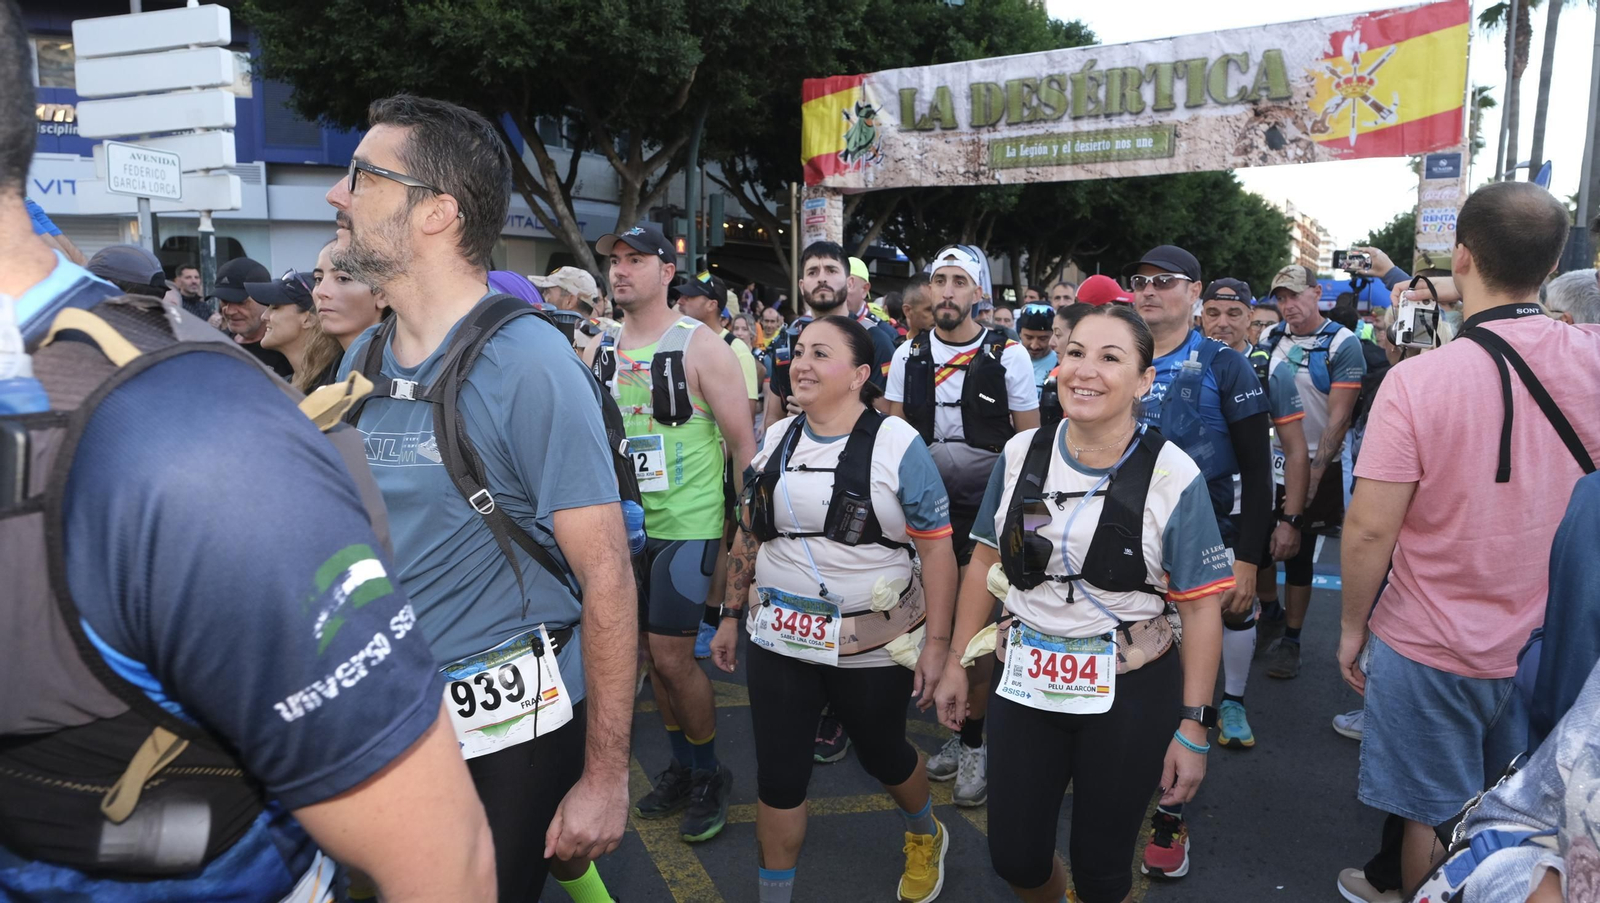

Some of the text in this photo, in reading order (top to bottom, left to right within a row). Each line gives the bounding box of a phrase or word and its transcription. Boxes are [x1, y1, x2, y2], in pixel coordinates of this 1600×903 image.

[899, 48, 1294, 131] LA DESÉRTICA
[1006, 137, 1154, 158] La Legión y el desierto nos une
[130, 152, 177, 167] AVENIDA
[124, 163, 166, 180] FEDERICO
[113, 176, 177, 195] GARCÍA LORCA
[1423, 214, 1456, 222] RENTA
[1201, 549, 1210, 557] LA
[1202, 557, 1211, 565] EL
[1212, 561, 1227, 571] NOS
[771, 607, 828, 641] 3493
[780, 633, 796, 641] SABES
[797, 636, 808, 644] UNA
[1028, 648, 1099, 685] 3494
[451, 663, 526, 719] 939
[1011, 680, 1022, 688] BUS
[1048, 683, 1097, 693] PELU ALARCÓN
[1002, 686, 1026, 698] asisa
[521, 695, 543, 709] FRAN
